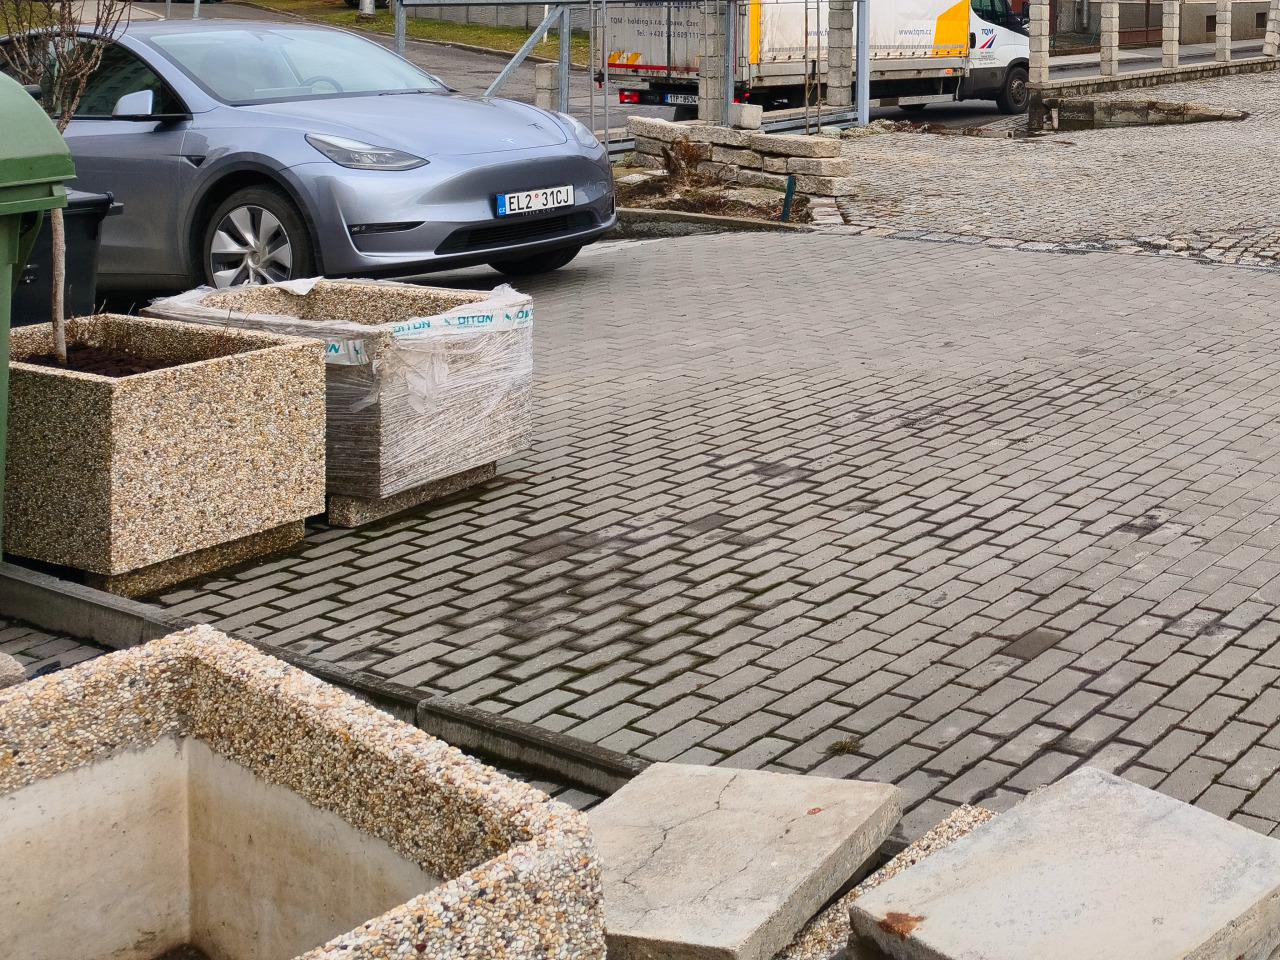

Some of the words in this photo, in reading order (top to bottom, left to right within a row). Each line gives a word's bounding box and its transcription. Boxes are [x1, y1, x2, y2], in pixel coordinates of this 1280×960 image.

[627, 17, 649, 26] holding
[898, 28, 932, 36] www.tqm.cz
[981, 28, 994, 36] TQM
[508, 193, 533, 211] EL2
[541, 188, 569, 207] 31CJ
[457, 313, 494, 325] DITON
